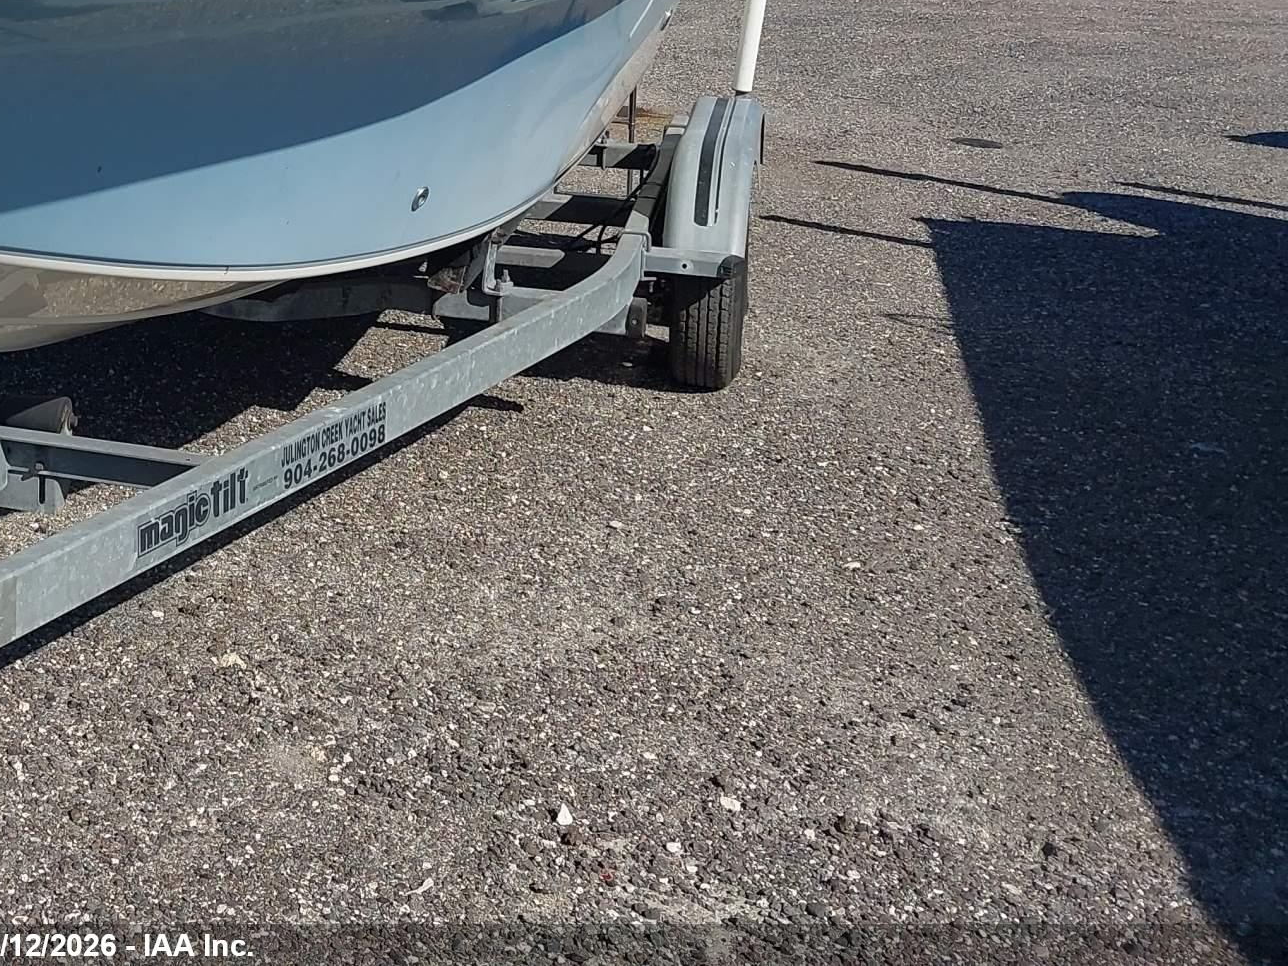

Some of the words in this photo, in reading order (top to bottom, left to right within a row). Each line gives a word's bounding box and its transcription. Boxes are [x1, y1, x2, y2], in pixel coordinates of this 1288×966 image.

[281, 430, 321, 468] JULINGTON
[321, 420, 343, 449] CREEK
[344, 411, 367, 437] YACHT
[367, 401, 387, 427] SALES
[283, 424, 386, 489] 904-268-0098
[138, 491, 211, 557] magic
